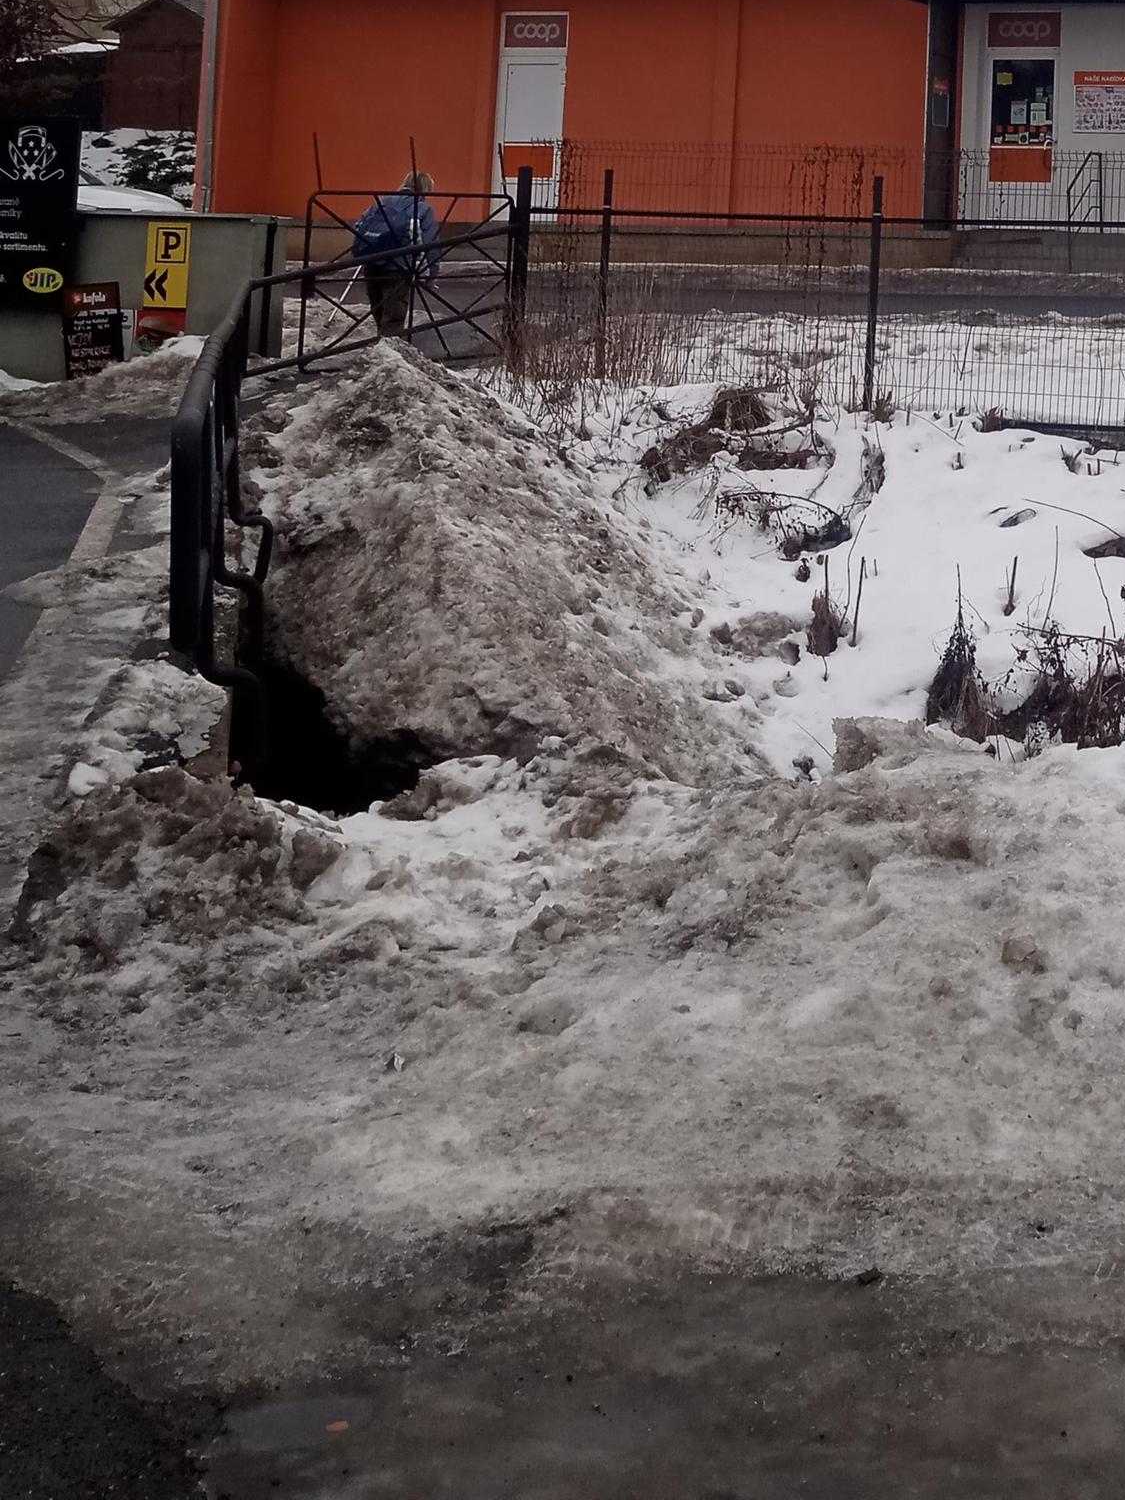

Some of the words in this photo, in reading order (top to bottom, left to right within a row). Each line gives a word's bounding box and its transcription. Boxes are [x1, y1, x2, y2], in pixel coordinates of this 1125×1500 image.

[513, 22, 560, 42] coop
[999, 20, 1051, 41] coop
[160, 231, 181, 260] P
